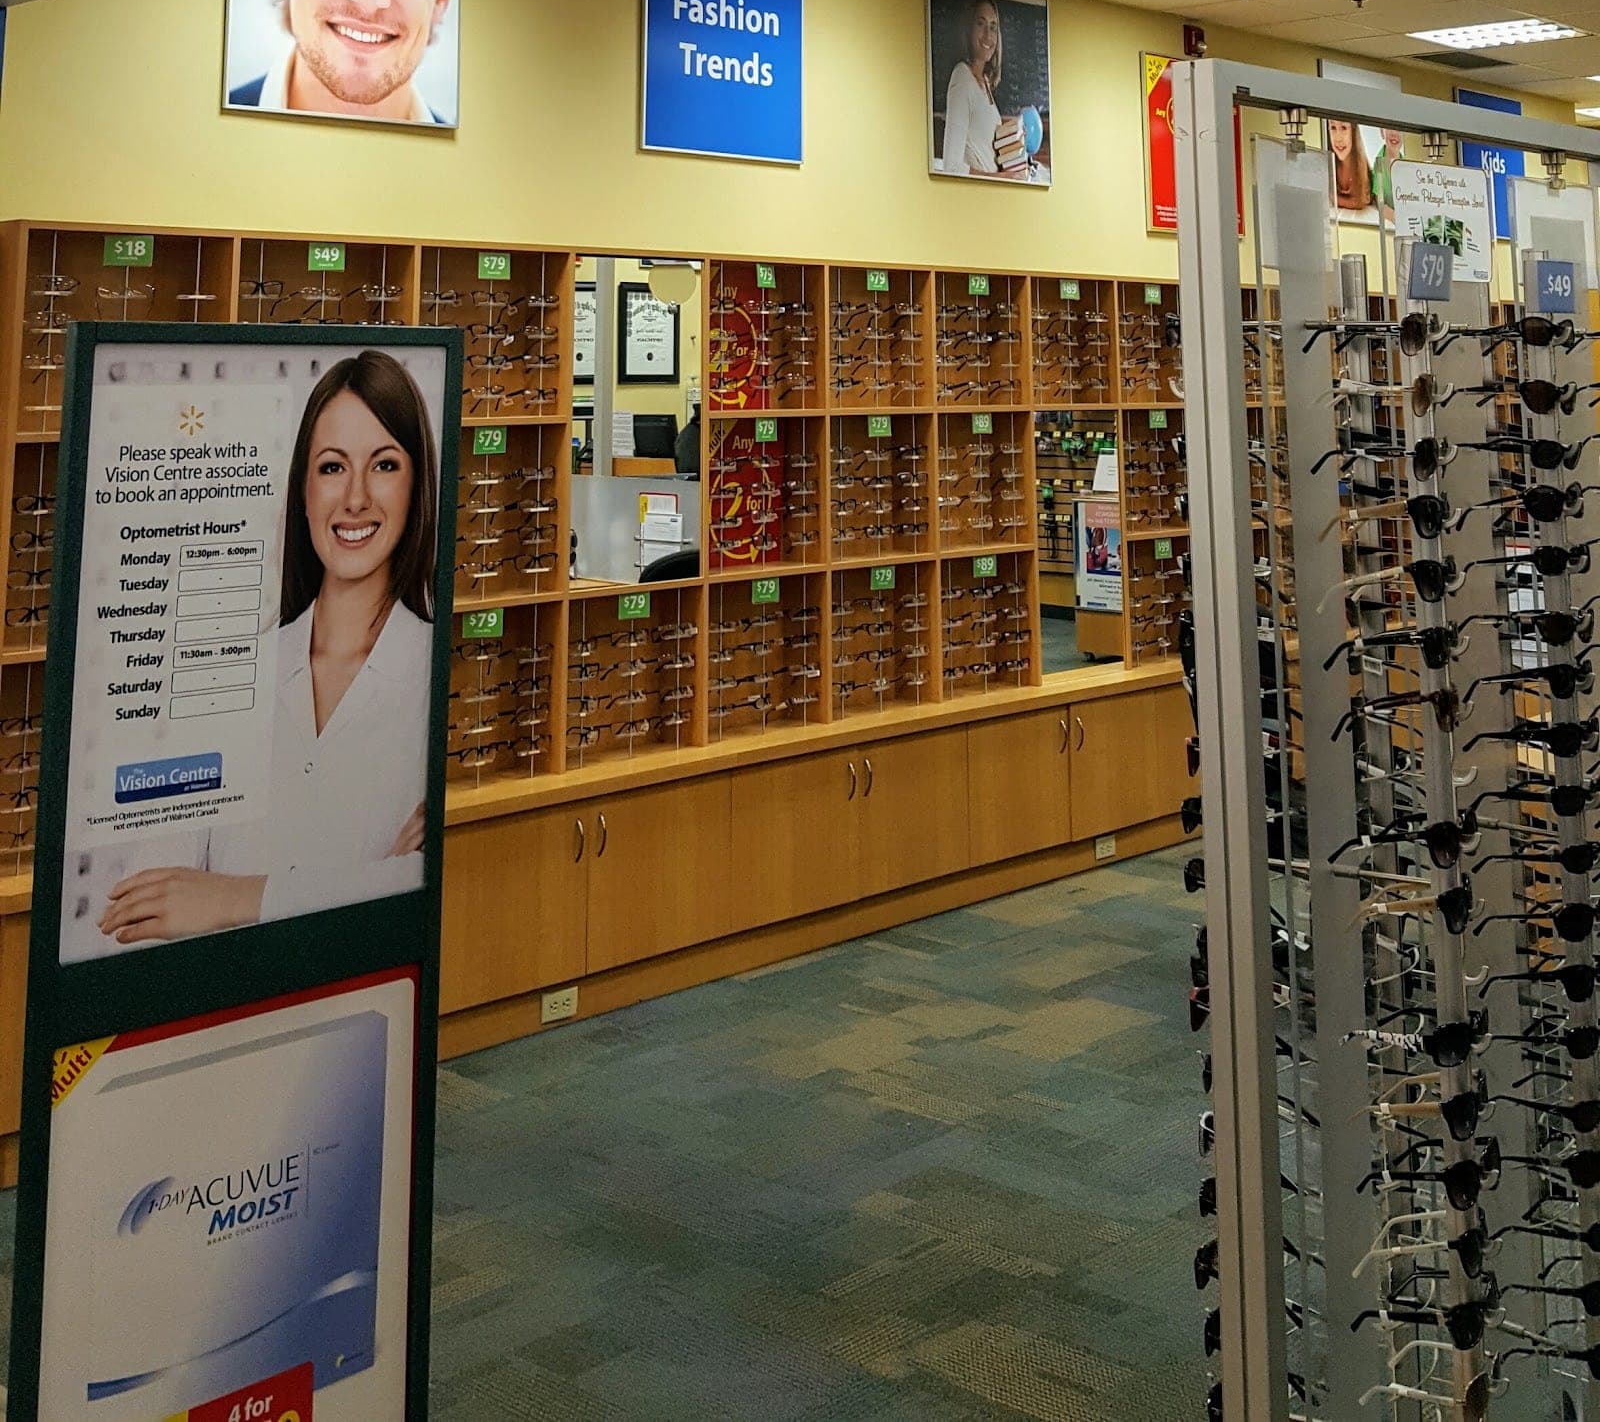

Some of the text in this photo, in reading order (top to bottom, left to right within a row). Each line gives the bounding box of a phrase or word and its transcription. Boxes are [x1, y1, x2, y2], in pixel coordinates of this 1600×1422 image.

[679, 42, 774, 87] Trends
[1481, 150, 1506, 174] Kids
[114, 241, 146, 258] $18
[314, 247, 340, 262] $49
[484, 256, 505, 271] $79
[1422, 254, 1445, 286] $79
[760, 267, 772, 281] $79
[870, 272, 885, 285] $79
[716, 283, 738, 299] Any
[971, 277, 986, 289] $79
[1548, 274, 1571, 297] $49
[759, 421, 774, 435] $79
[873, 417, 888, 429] $79
[478, 430, 502, 446] $79
[732, 435, 754, 453] Any
[119, 442, 257, 463] Please speak with a
[105, 462, 268, 483] Vision Centre associate
[96, 482, 274, 504] to book an appointment.
[746, 495, 763, 511] for
[120, 523, 200, 542] Optometrist
[120, 551, 171, 566] Monday
[186, 549, 219, 559] 12:30pm
[227, 547, 257, 557] 6:00pm
[976, 558, 993, 570] $89
[875, 569, 893, 581] $79
[119, 577, 169, 592] Tuesday
[756, 580, 775, 594] $79
[97, 602, 168, 619] Wednesday
[623, 595, 646, 609] $79
[469, 612, 497, 629] $79
[109, 628, 166, 644] Thursday
[126, 653, 164, 668] Friday
[180, 650, 213, 660] 11:30am
[107, 679, 163, 696] Saturday
[115, 705, 160, 721] Sunday
[120, 766, 218, 792] Vision Centre
[114, 808, 219, 831] not employees of Walmart Canada
[118, 807, 161, 820] Optometrists
[161, 806, 171, 814] are
[51, 1045, 93, 1099] Multi
[208, 1187, 299, 1235] MOIST
[207, 1233, 233, 1246] BRAND
[236, 1221, 269, 1238] CONTACT
[228, 1403, 241, 1422] 4
[245, 1394, 273, 1420] for
